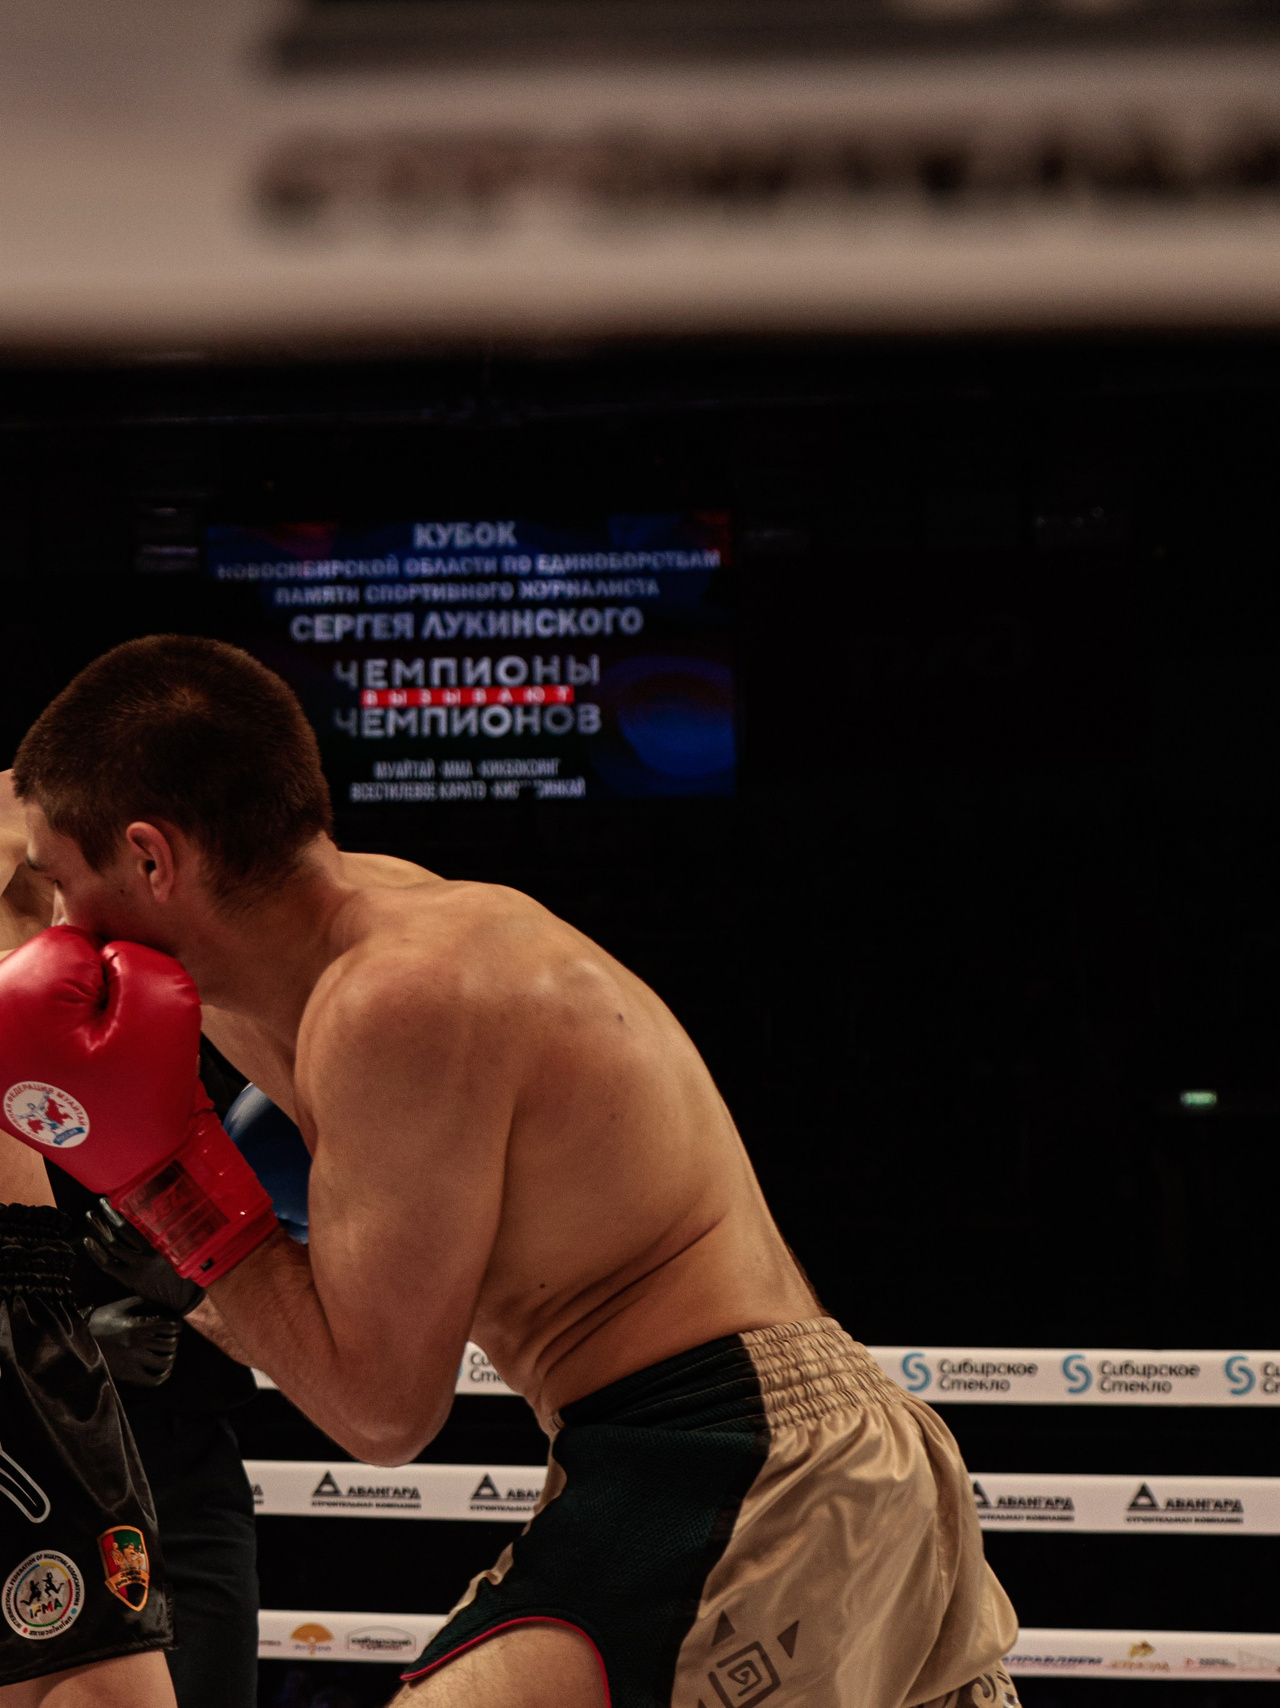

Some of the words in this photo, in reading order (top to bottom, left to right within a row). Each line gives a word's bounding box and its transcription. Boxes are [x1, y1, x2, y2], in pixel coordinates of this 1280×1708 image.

[413, 521, 517, 548] КУБОК
[403, 555, 498, 577] ОБЛАСТИ
[501, 554, 532, 575] ПО
[274, 584, 360, 605] ПАМЯТИ
[363, 581, 514, 604] СПОРТИВНОГО
[519, 577, 660, 599] ЖУРНАЛИСТА
[290, 612, 415, 642] СЕРГЕЯ
[422, 606, 644, 640] ЛУКИНСКОГО
[334, 654, 600, 689] ЧЕМПИОНЫ
[364, 685, 570, 706] ВЫЗЫВАЮТ
[334, 703, 601, 737] ЧЕМПИОНОВ
[939, 1358, 1039, 1378] Сибирское
[1099, 1360, 1201, 1380] Сибирское
[938, 1375, 1011, 1392] Стекло
[1099, 1376, 1173, 1393] Стекло
[347, 1486, 420, 1500] АВАНГАРД
[997, 1496, 1075, 1510] АВАНГАРД
[1165, 1498, 1244, 1513] АВАНГАРД
[10, 1558, 36, 1586] FEDERATION
[29, 1597, 63, 1619] IFMA
